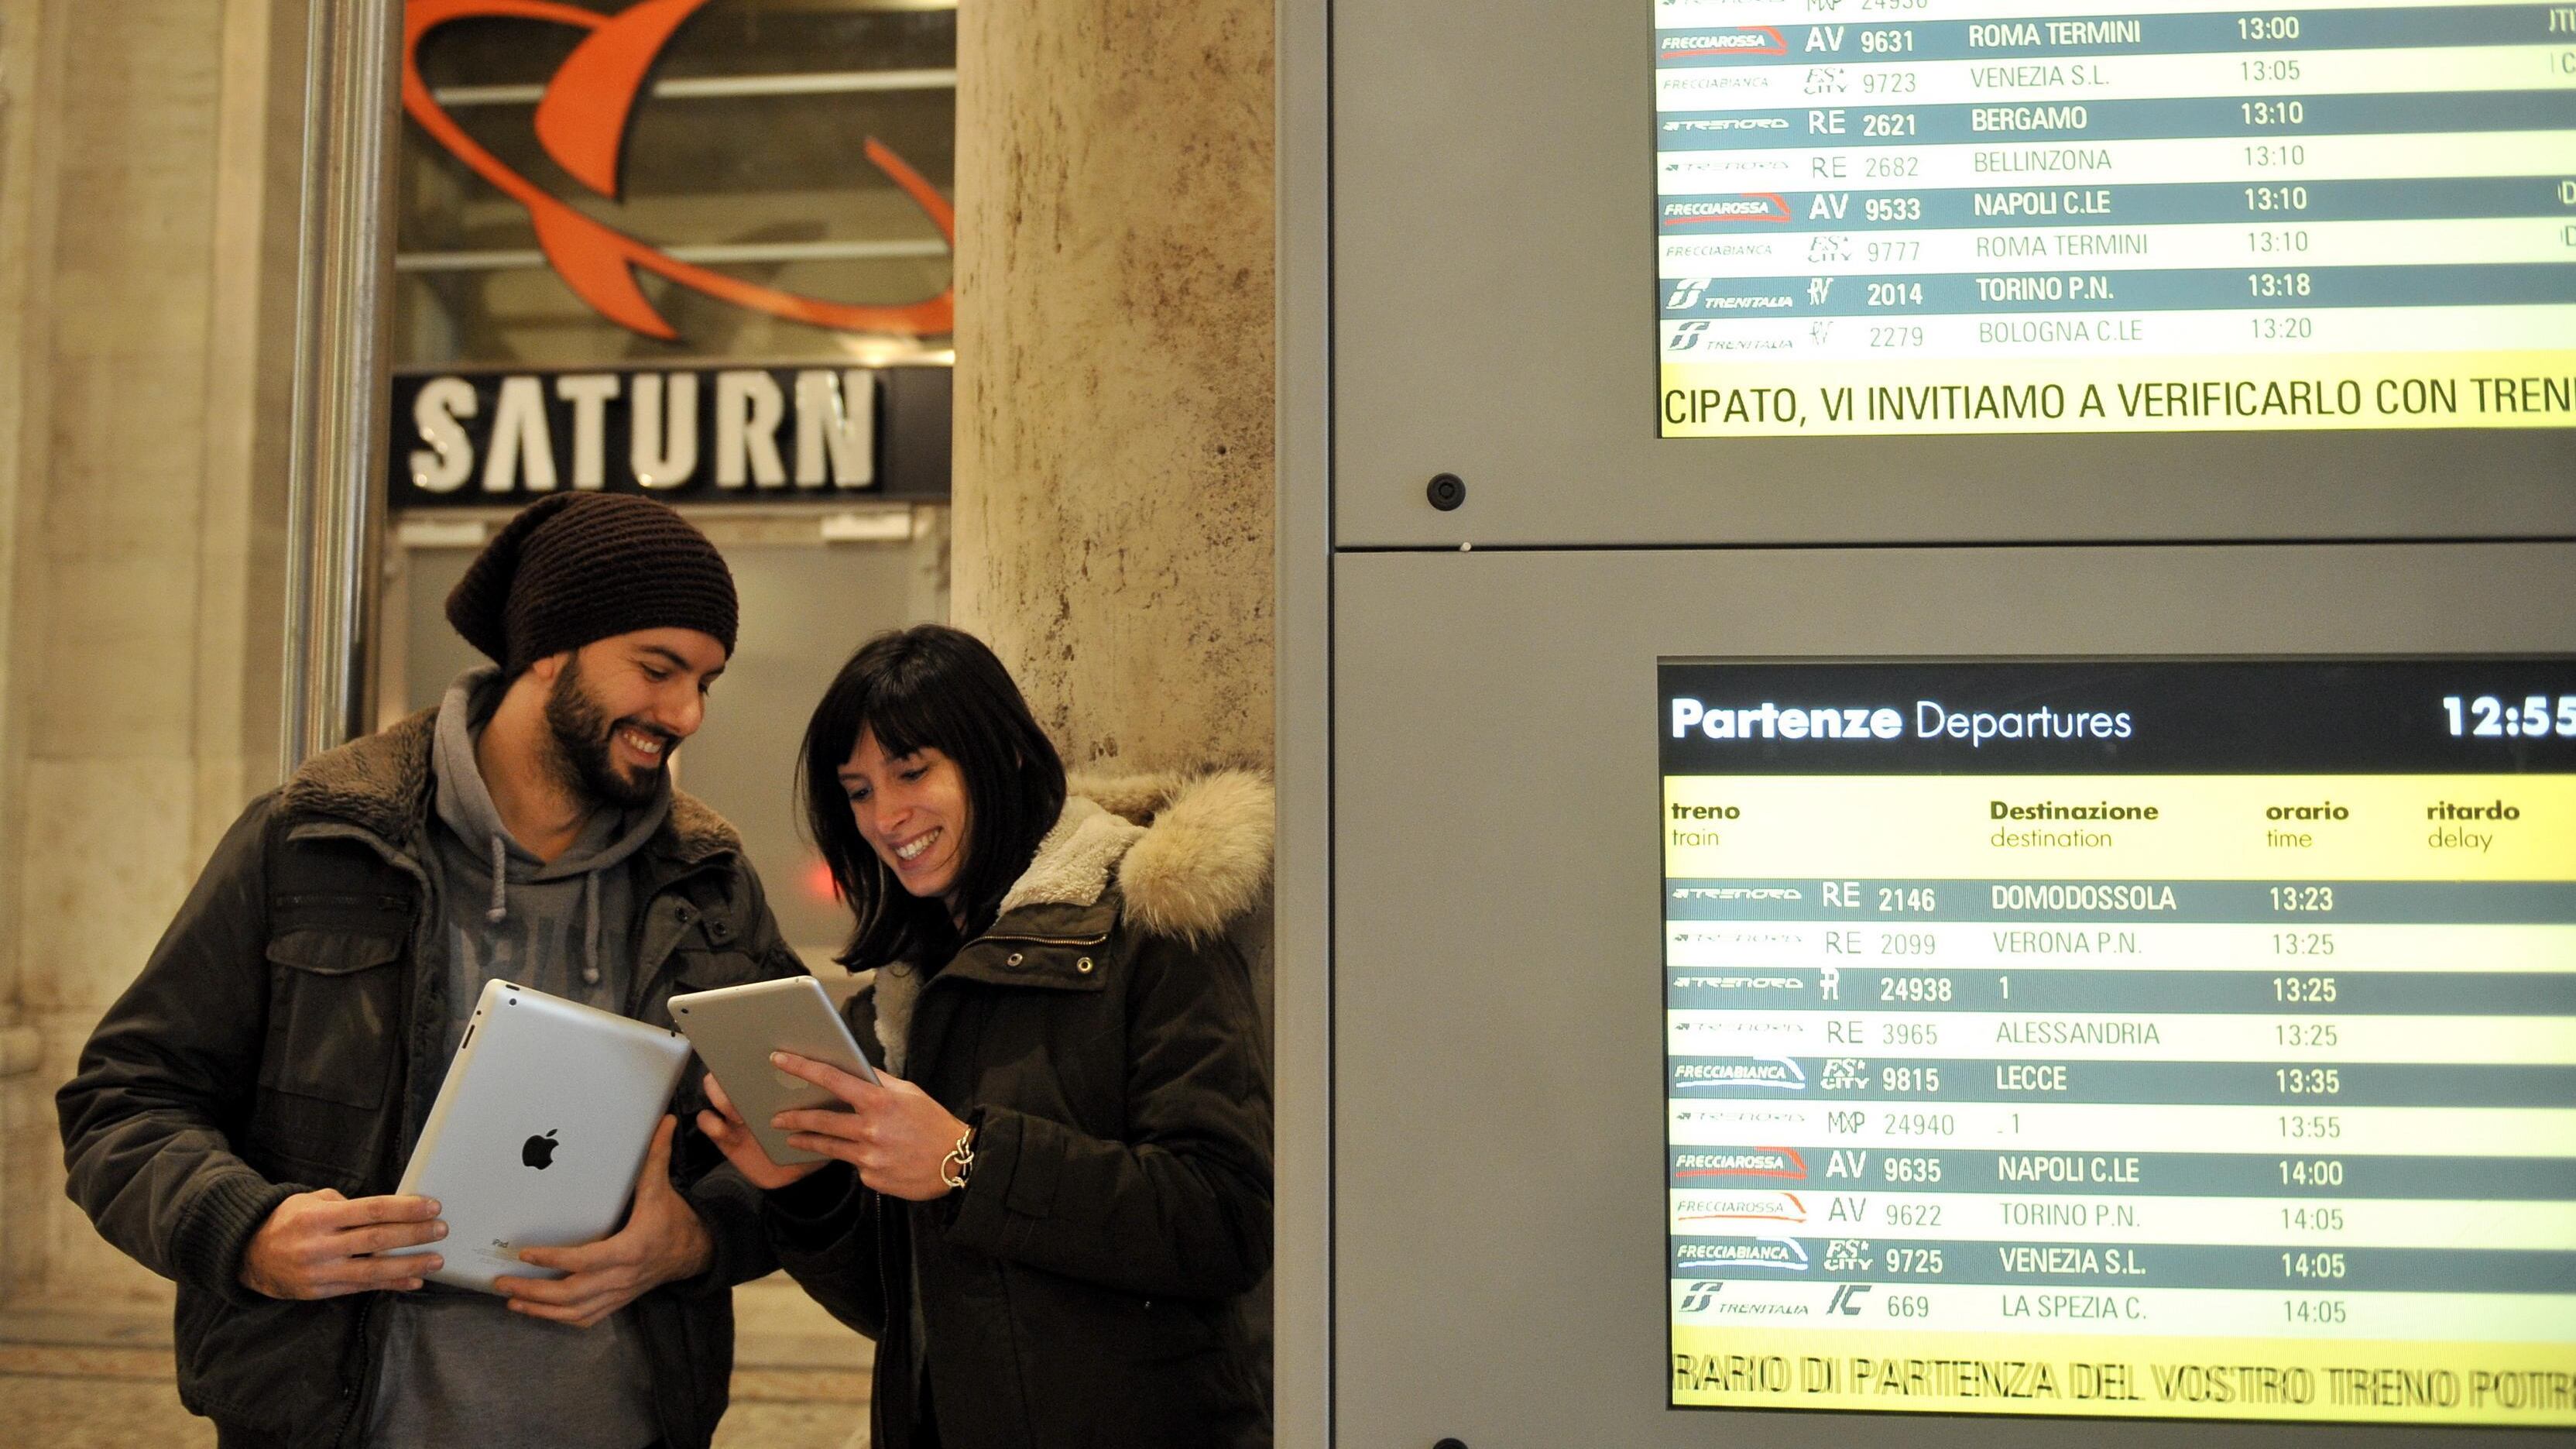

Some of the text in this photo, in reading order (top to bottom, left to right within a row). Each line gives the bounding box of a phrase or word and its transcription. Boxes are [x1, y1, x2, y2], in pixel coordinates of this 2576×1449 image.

[1662, 35, 1765, 49] FRECCIAROSSA
[1805, 26, 1844, 52] AV
[1861, 29, 1914, 53] 9631
[1969, 23, 2041, 48] ROMA
[2046, 20, 2142, 48] TERMINI
[2238, 16, 2300, 40] 13:00
[1864, 73, 1916, 94] 9723
[1971, 67, 2064, 88] VENEZIA
[2072, 65, 2111, 86] S.L.
[2242, 60, 2300, 81] 13:05
[1809, 110, 1845, 135] RE
[1863, 115, 1916, 136] 2621
[1971, 106, 2087, 131] BERGAMO
[2242, 101, 2303, 125] 13:10
[1812, 156, 1847, 178] RE
[1865, 157, 1919, 178] 2682
[1974, 149, 2112, 173] BELLINZONA
[2245, 145, 2305, 167] 13:10
[1665, 201, 1769, 215] FRECCIAROSSA
[1809, 194, 1848, 219] AV
[1865, 198, 1921, 221] 9533
[1974, 192, 2057, 215] NAPOLI
[2063, 191, 2111, 214] C.LE
[2245, 187, 2307, 211] 13:10
[1868, 242, 1921, 262] 9777
[1977, 236, 2048, 257] ROMA
[2057, 234, 2148, 256] TERMINI
[2248, 231, 2308, 252] 13:10
[1705, 296, 1792, 308] TRENITALIA
[1868, 283, 1923, 306] 2014
[1976, 277, 2063, 302] TORINO
[2069, 276, 2115, 300] P.N.
[2248, 273, 2311, 297] 13:18
[1871, 328, 1923, 348] 2279
[1980, 321, 2090, 344] BOLOGNA
[2097, 320, 2142, 341] C.LE
[2252, 318, 2312, 338] 13:20
[1665, 388, 1807, 427] CIPATO,
[1821, 387, 1853, 421] VI
[1869, 384, 2064, 421] INVITIAMO
[2080, 384, 2106, 418] A
[2117, 379, 2362, 417] VERIFICARLO
[2376, 379, 2458, 414] CON
[410, 370, 875, 493] SATURN
[1671, 695, 2576, 747] Partenze Departures 12:55
[1672, 802, 1741, 820] treno
[1990, 801, 2159, 821] Destinazione
[2266, 801, 2349, 821] orario
[2427, 799, 2520, 821] ritardo
[1672, 828, 1719, 846] train
[1991, 826, 2112, 848] destination
[2267, 828, 2312, 848] time
[2428, 826, 2492, 852] delay
[1822, 881, 1861, 908] RE
[1878, 888, 1935, 912] 2146
[1992, 885, 2176, 911] DOMODOSSOLA
[2270, 886, 2334, 911] 13:23
[1827, 932, 2334, 956] RE 2099 VERONA P.N. 13:25
[1880, 977, 1952, 1001] 24938
[1999, 976, 2008, 999] 1
[2273, 977, 2337, 1002] 13:25
[1828, 1021, 1863, 1043] RE
[1882, 1023, 1938, 1046] 3965
[1996, 1022, 2160, 1045] ALESSANDRIA
[2276, 1024, 2338, 1047] 13:25
[1674, 1065, 1786, 1078] FRECCIABIANCA
[1882, 1067, 1939, 1092] 9815
[1996, 1066, 2067, 1091] LECCE
[2276, 1069, 2340, 1094] 13:35
[1885, 1114, 1954, 1135] 24940
[2279, 1115, 2341, 1138] 13:55
[1676, 1151, 2344, 1186] FRECCIAROSSA AV 9635 NAPOLI C.LE 14:00
[1677, 1197, 2344, 1231] FRECCIAROSSA AV 9622 TORINO P.N. 14:05
[1677, 1245, 1789, 1260] FRECCIABIANCA
[1886, 1248, 1943, 1274] 9725
[1998, 1246, 2100, 1273] VENEZIA
[2104, 1249, 2146, 1275] S.L.
[2282, 1253, 2346, 1279] 14:05
[1719, 1303, 1809, 1314] TRENITALIA
[1888, 1295, 1929, 1318] 669
[2002, 1294, 2032, 1317] LA
[2038, 1294, 2120, 1319] SPEZIA
[2125, 1296, 2146, 1320] C.
[2284, 1300, 2347, 1324] 14:05
[1800, 1356, 1841, 1393] DI
[1850, 1358, 2061, 1399] PARTENZA
[2070, 1361, 2143, 1401] DEL
[2152, 1364, 2315, 1404] VOSTRO
[2322, 1367, 2460, 1407] TRENO
[2468, 1371, 2576, 1410] POTR
